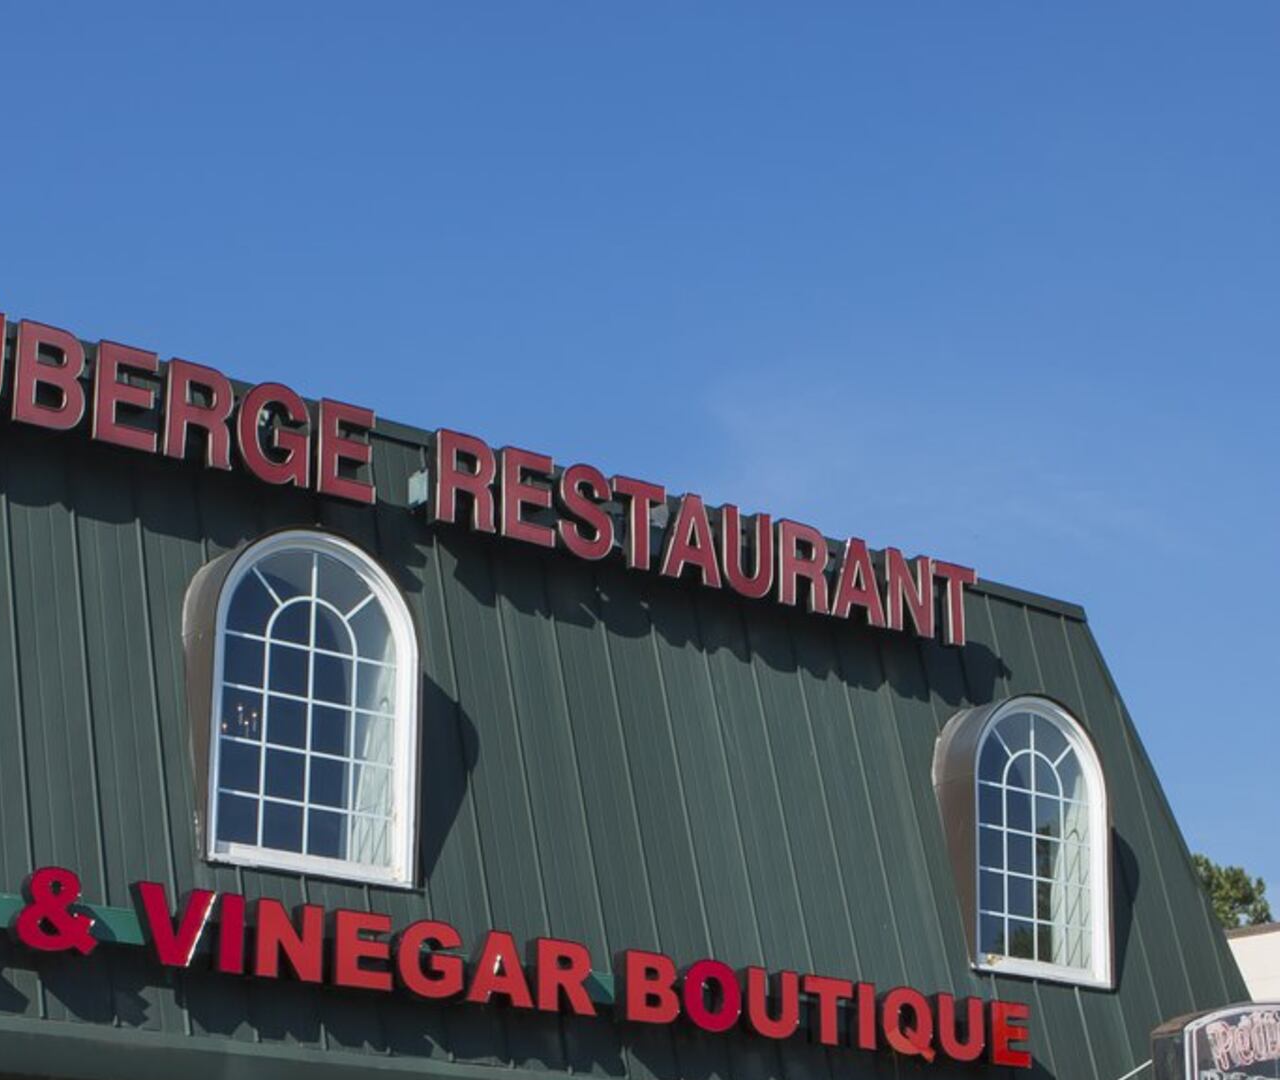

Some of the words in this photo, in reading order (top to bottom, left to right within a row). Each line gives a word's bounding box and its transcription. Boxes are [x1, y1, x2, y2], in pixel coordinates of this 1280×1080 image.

[431, 428, 977, 646] RESTAURANT
[15, 866, 98, 957] &
[131, 881, 596, 1017] VINEGAR
[616, 949, 1033, 1070] BOUTIQUE
